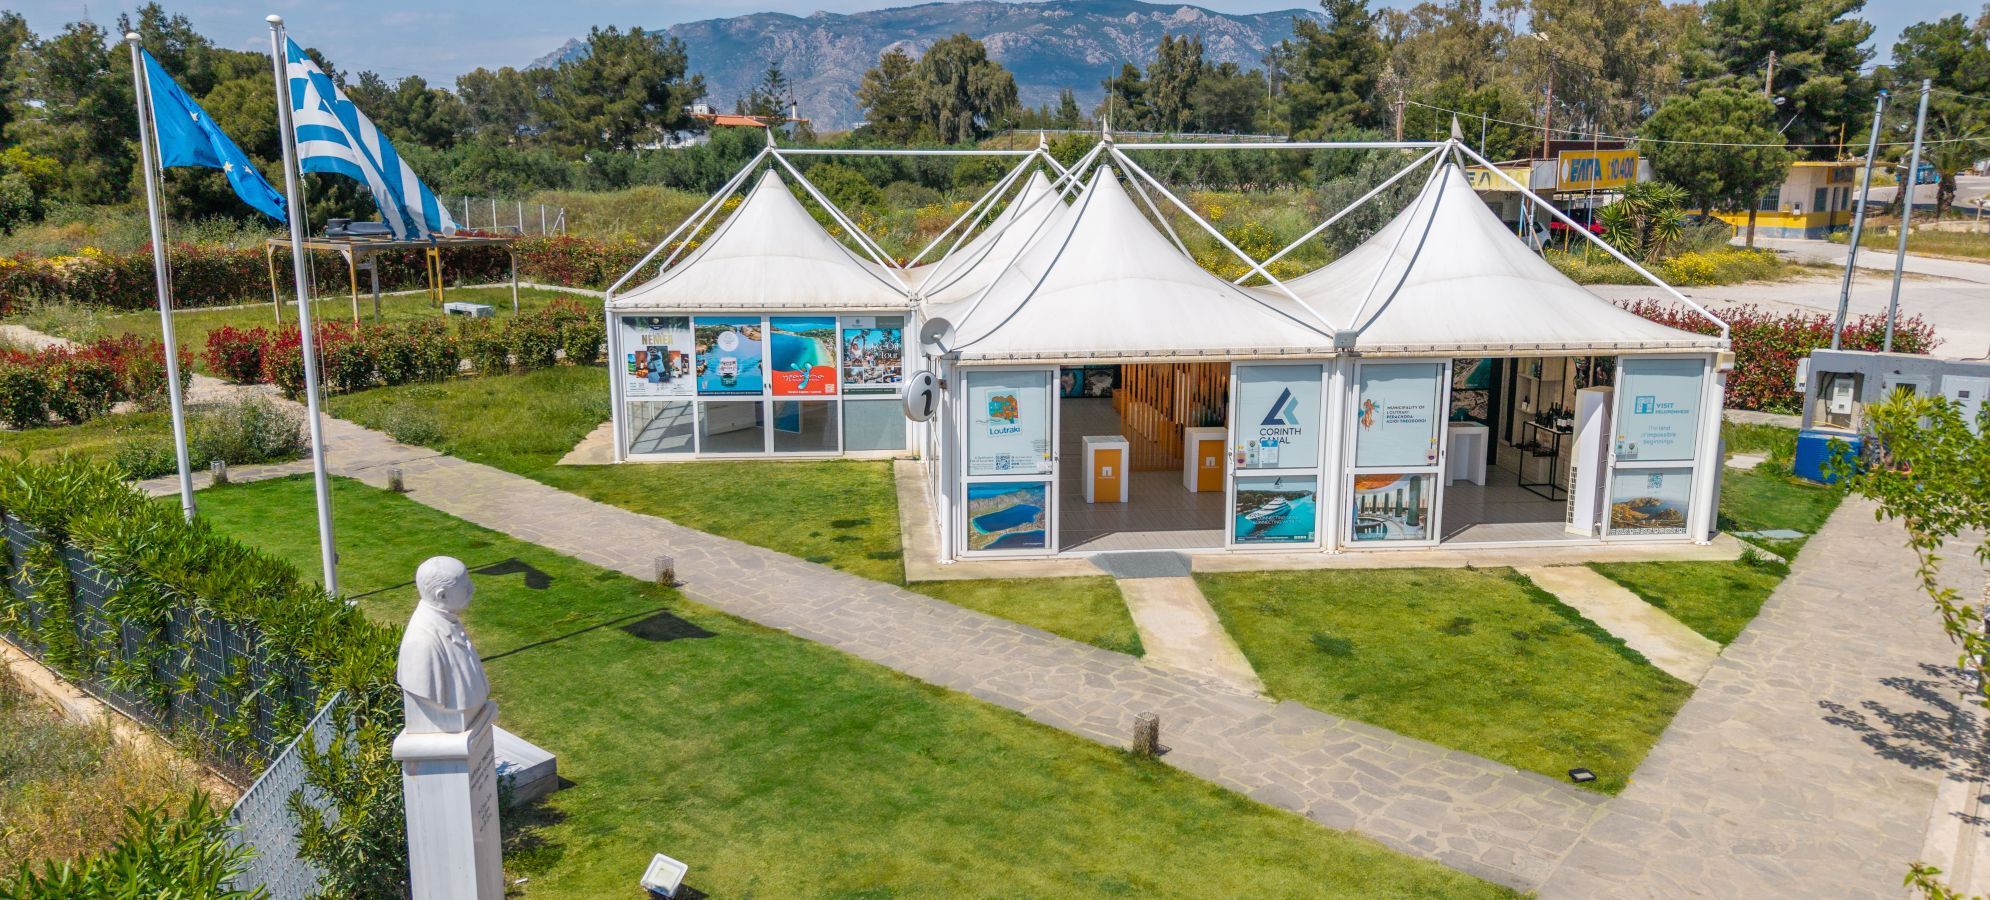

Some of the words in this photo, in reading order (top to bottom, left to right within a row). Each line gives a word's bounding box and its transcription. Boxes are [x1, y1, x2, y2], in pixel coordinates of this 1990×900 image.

[1570, 158, 1602, 182] ΕΛΠΑ
[641, 334, 673, 345] NEMEA
[989, 426, 1021, 435] Loutraki
[1259, 427, 1302, 436] CORINTH
